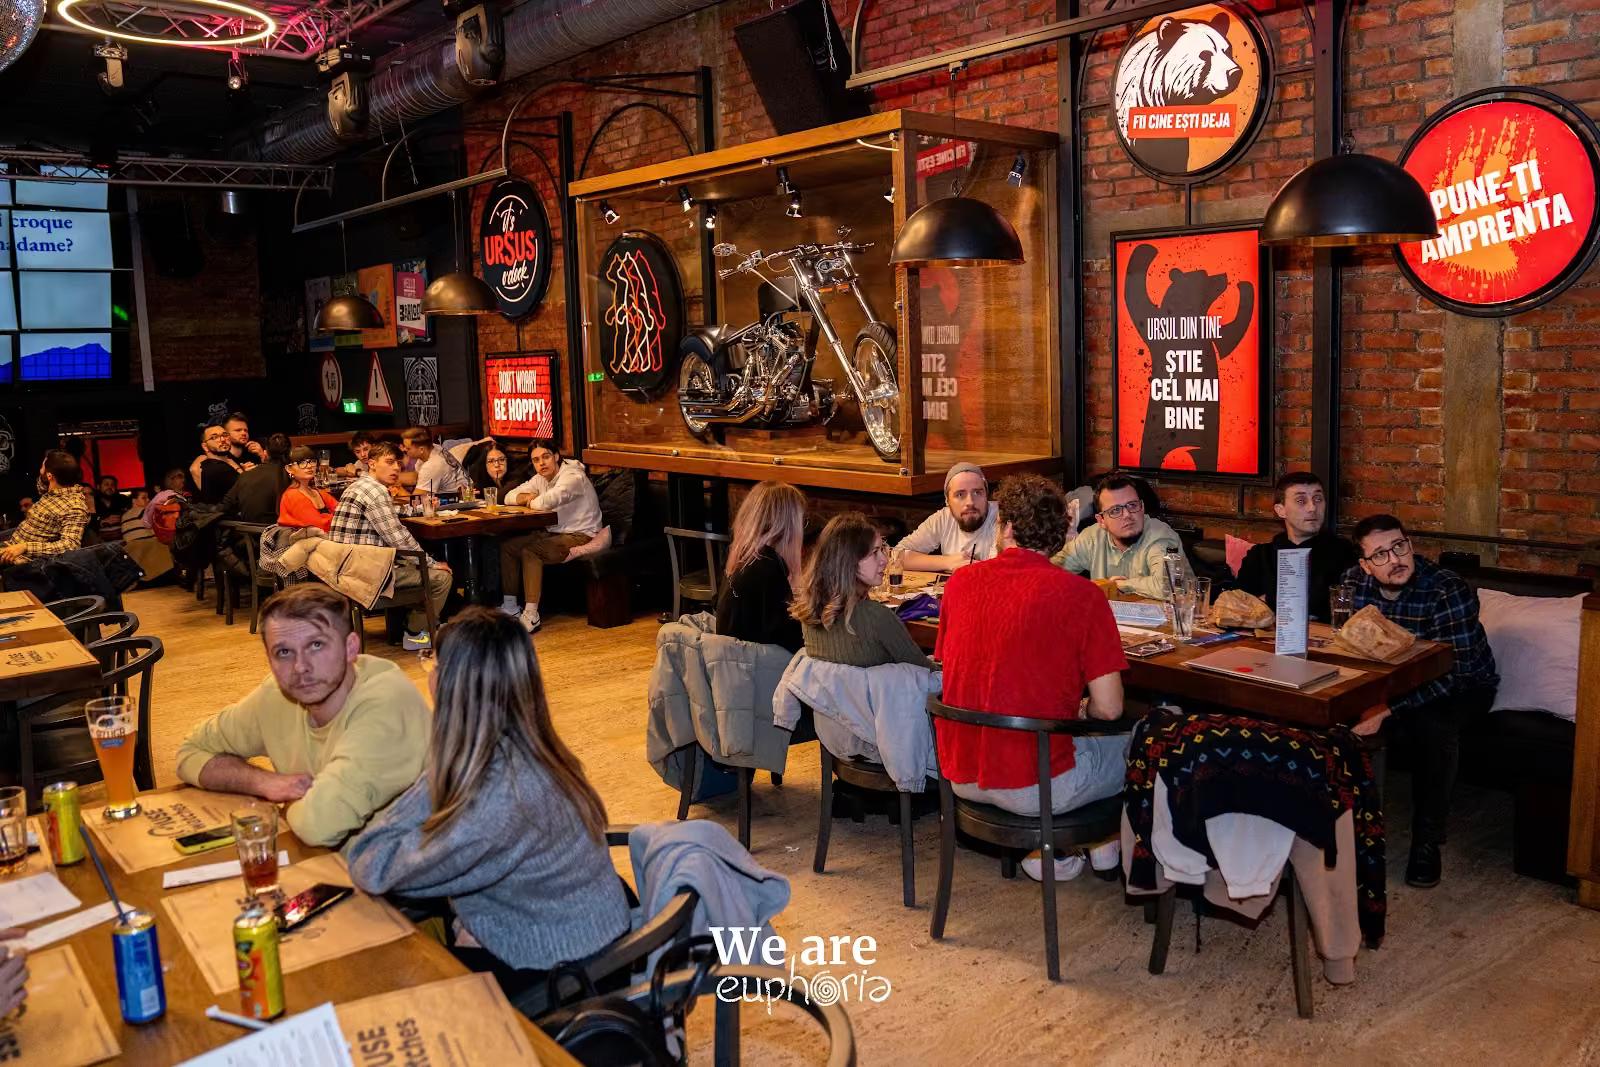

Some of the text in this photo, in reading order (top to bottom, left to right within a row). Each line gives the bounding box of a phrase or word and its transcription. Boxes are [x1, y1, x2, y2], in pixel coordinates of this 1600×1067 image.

[1132, 114, 1147, 129] FII
[1148, 113, 1174, 129] CINE
[1201, 112, 1231, 129] DEJA
[12, 217, 73, 234] croque
[1420, 192, 1574, 265] AMPRENTA
[484, 230, 537, 266] URSUS
[1147, 315, 1223, 340] URSUL DIN TINE
[498, 369, 537, 394] DON'T WORRY
[1151, 378, 1219, 402] CEL MAI
[494, 398, 547, 423] BE HOPPY!
[1164, 406, 1205, 430] BINE
